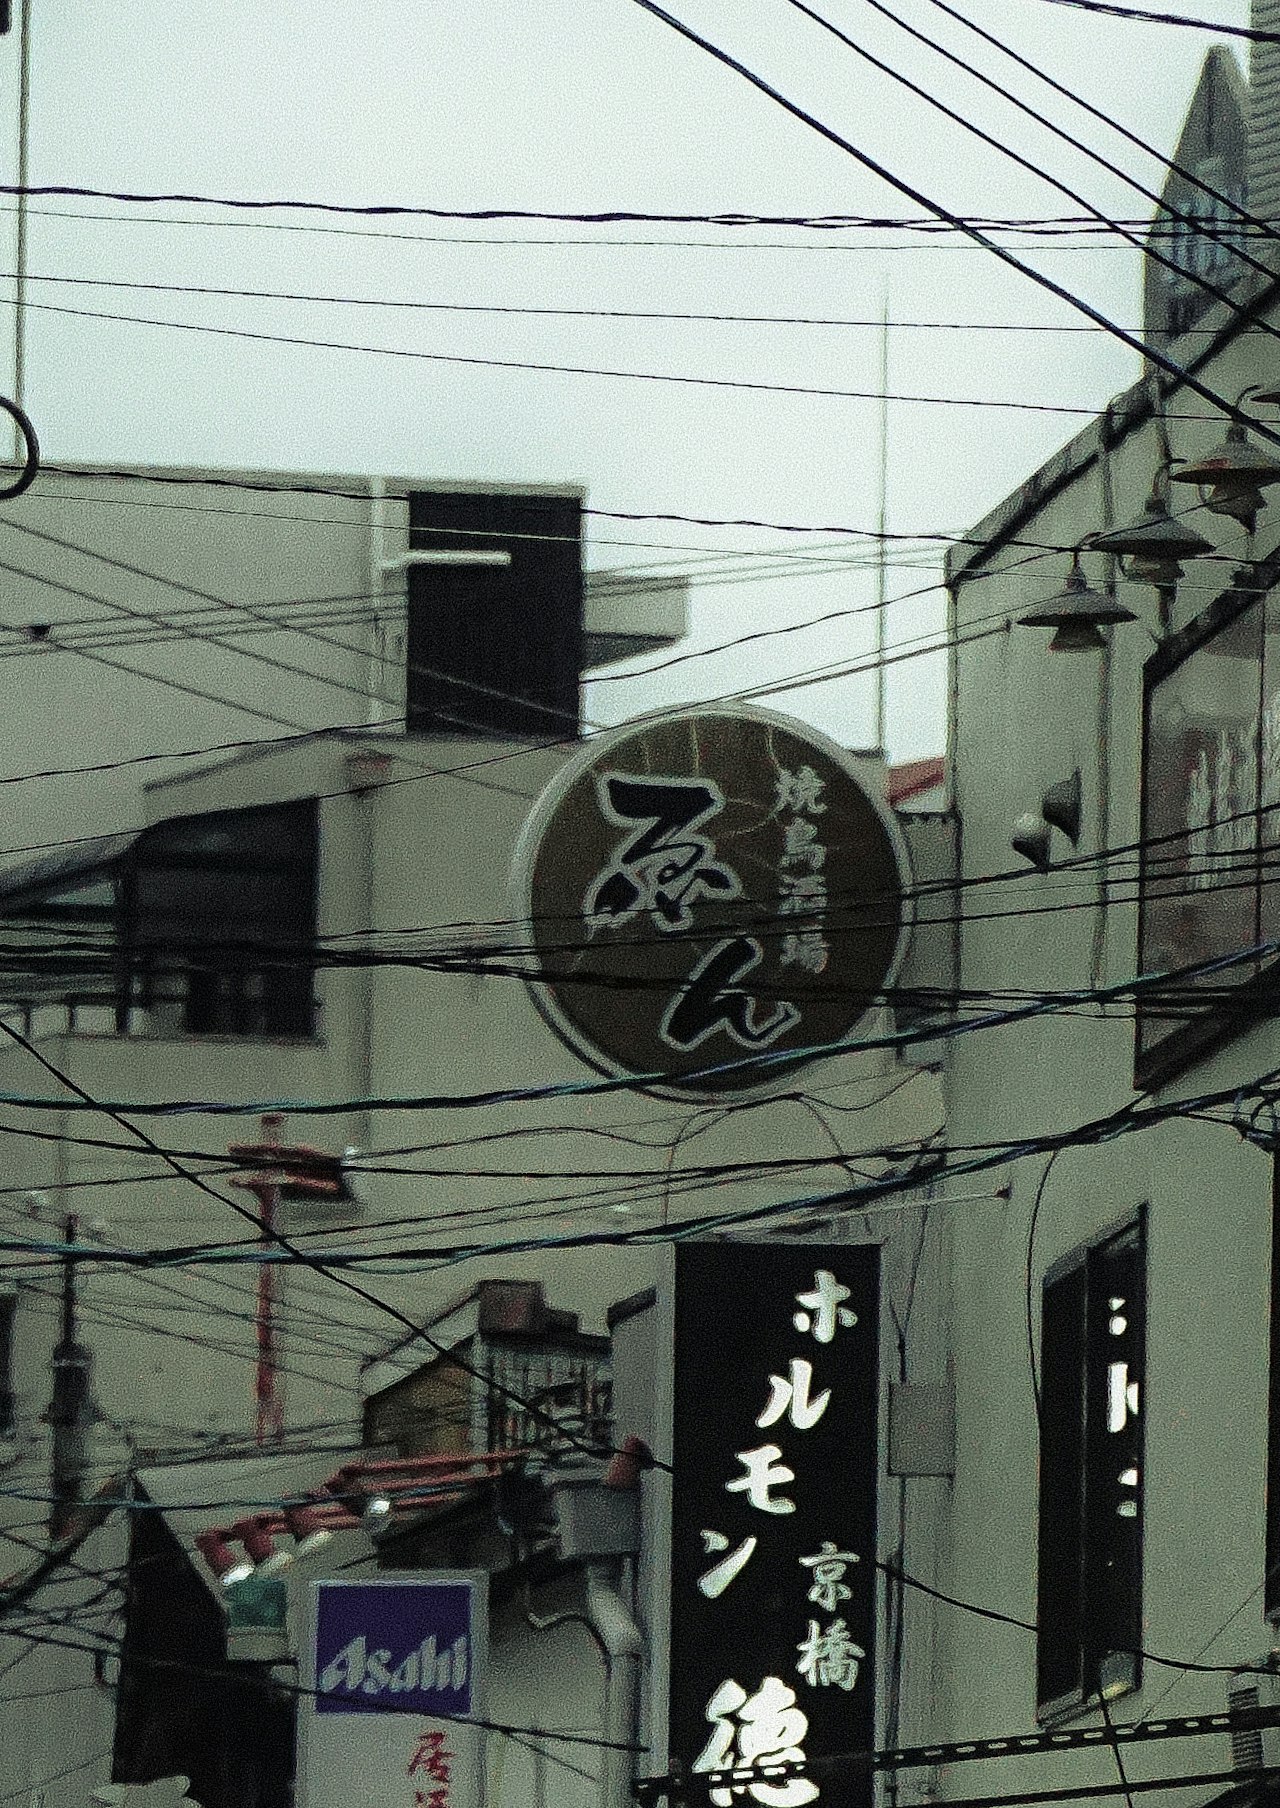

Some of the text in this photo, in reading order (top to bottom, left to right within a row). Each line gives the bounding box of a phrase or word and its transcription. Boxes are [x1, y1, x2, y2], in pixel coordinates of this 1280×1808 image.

[697, 1269, 857, 1599] ホルモン
[319, 1632, 472, 1697] Asahi
[797, 1541, 866, 1692] 京橋
